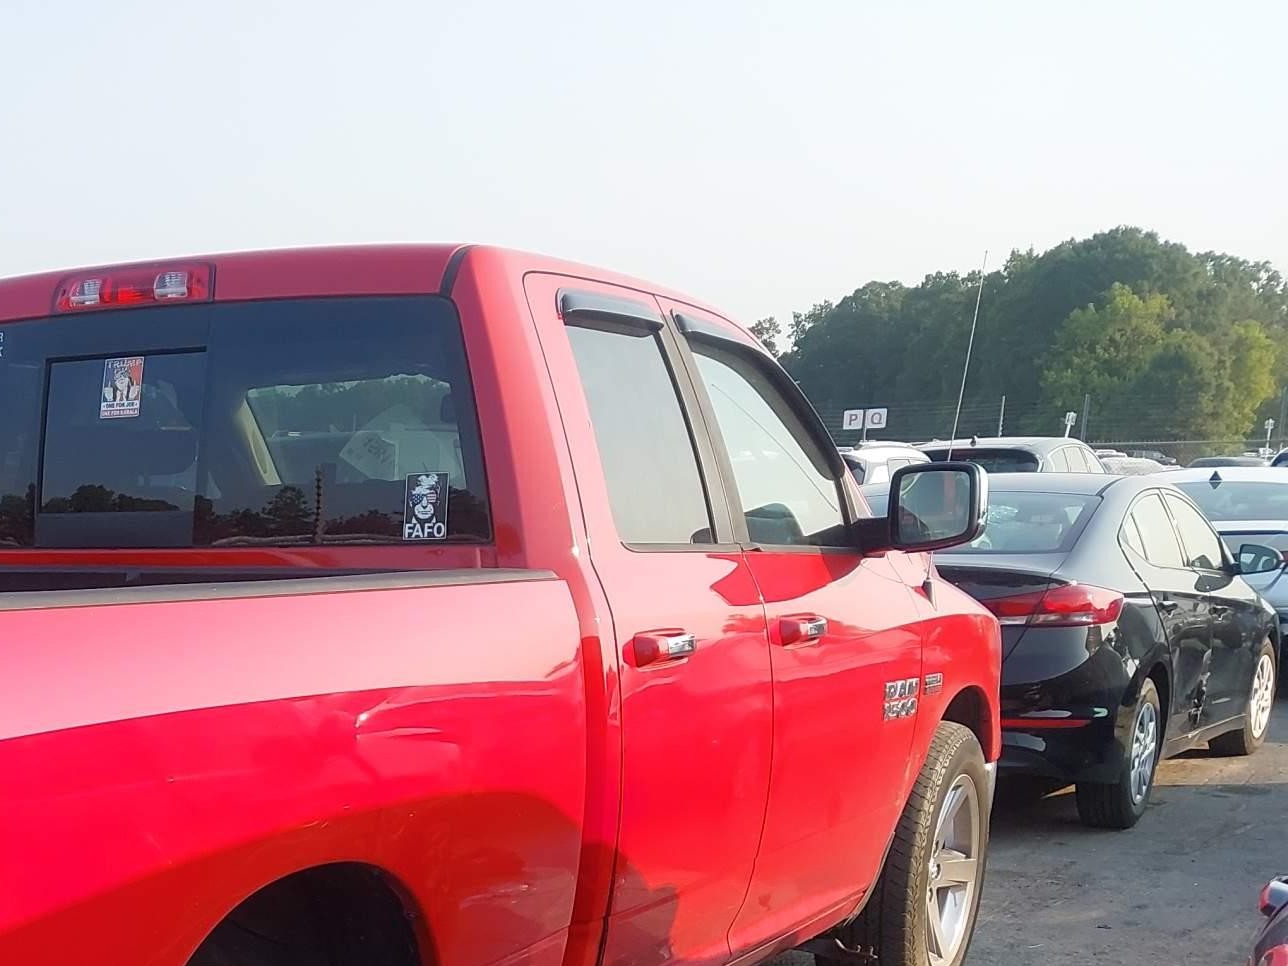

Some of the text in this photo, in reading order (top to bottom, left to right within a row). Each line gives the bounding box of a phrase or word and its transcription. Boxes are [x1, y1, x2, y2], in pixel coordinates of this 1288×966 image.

[107, 359, 142, 369] TRUMP
[849, 414, 858, 426] P
[871, 412, 882, 424] Q
[404, 522, 445, 538] FAFO
